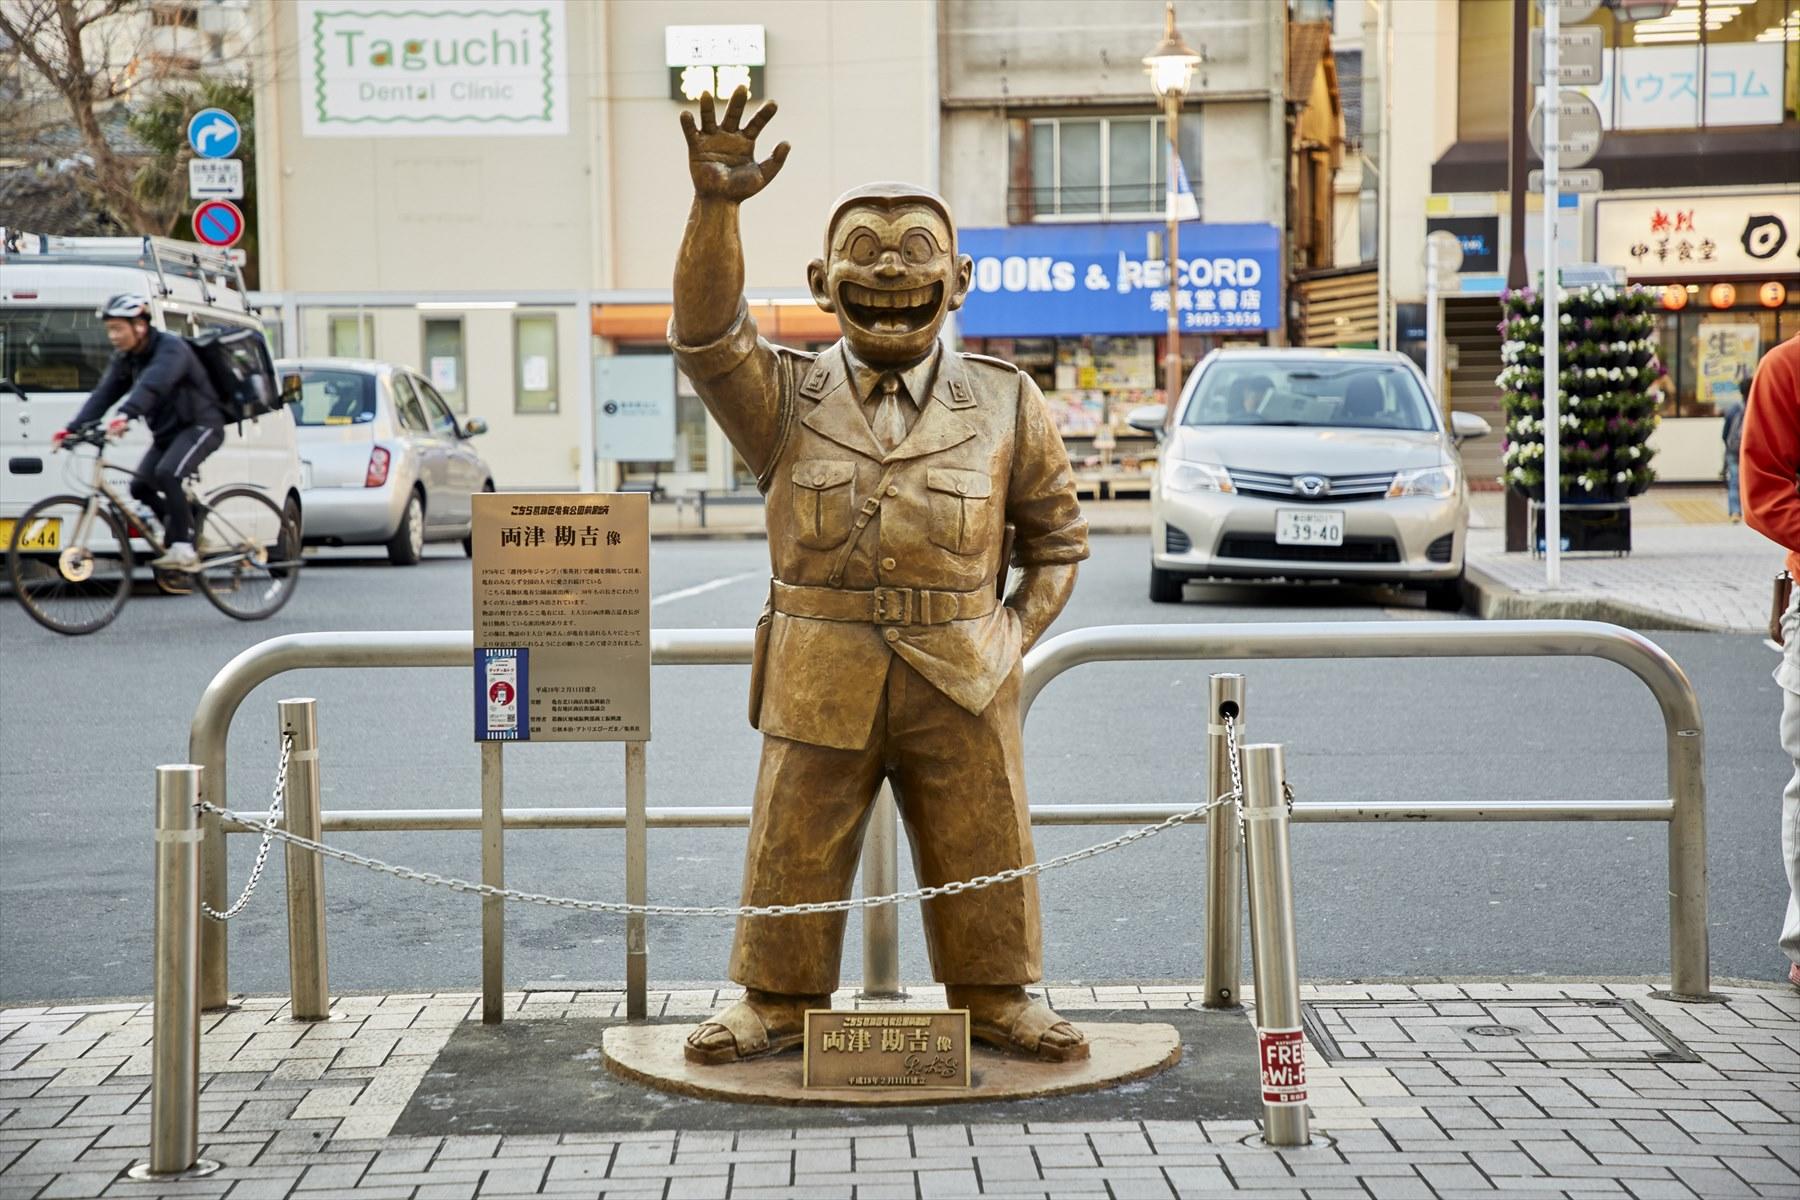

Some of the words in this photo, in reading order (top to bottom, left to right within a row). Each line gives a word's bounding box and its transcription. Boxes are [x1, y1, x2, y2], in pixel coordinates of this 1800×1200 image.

[334, 28, 530, 72] Taguchi
[358, 81, 436, 101] Dental
[449, 81, 514, 101] Clinic
[1600, 69, 1770, 103] ハウスコム
[1630, 237, 1718, 265] 中華食堂
[1084, 264, 1111, 290] &
[1126, 258, 1262, 288] RECORD
[500, 525, 545, 547] 両津
[554, 525, 600, 547] 勘吉
[606, 530, 622, 546] 像
[822, 1029, 873, 1052] 両津
[881, 1029, 930, 1052] 勘吉
[936, 1035, 953, 1052] 像
